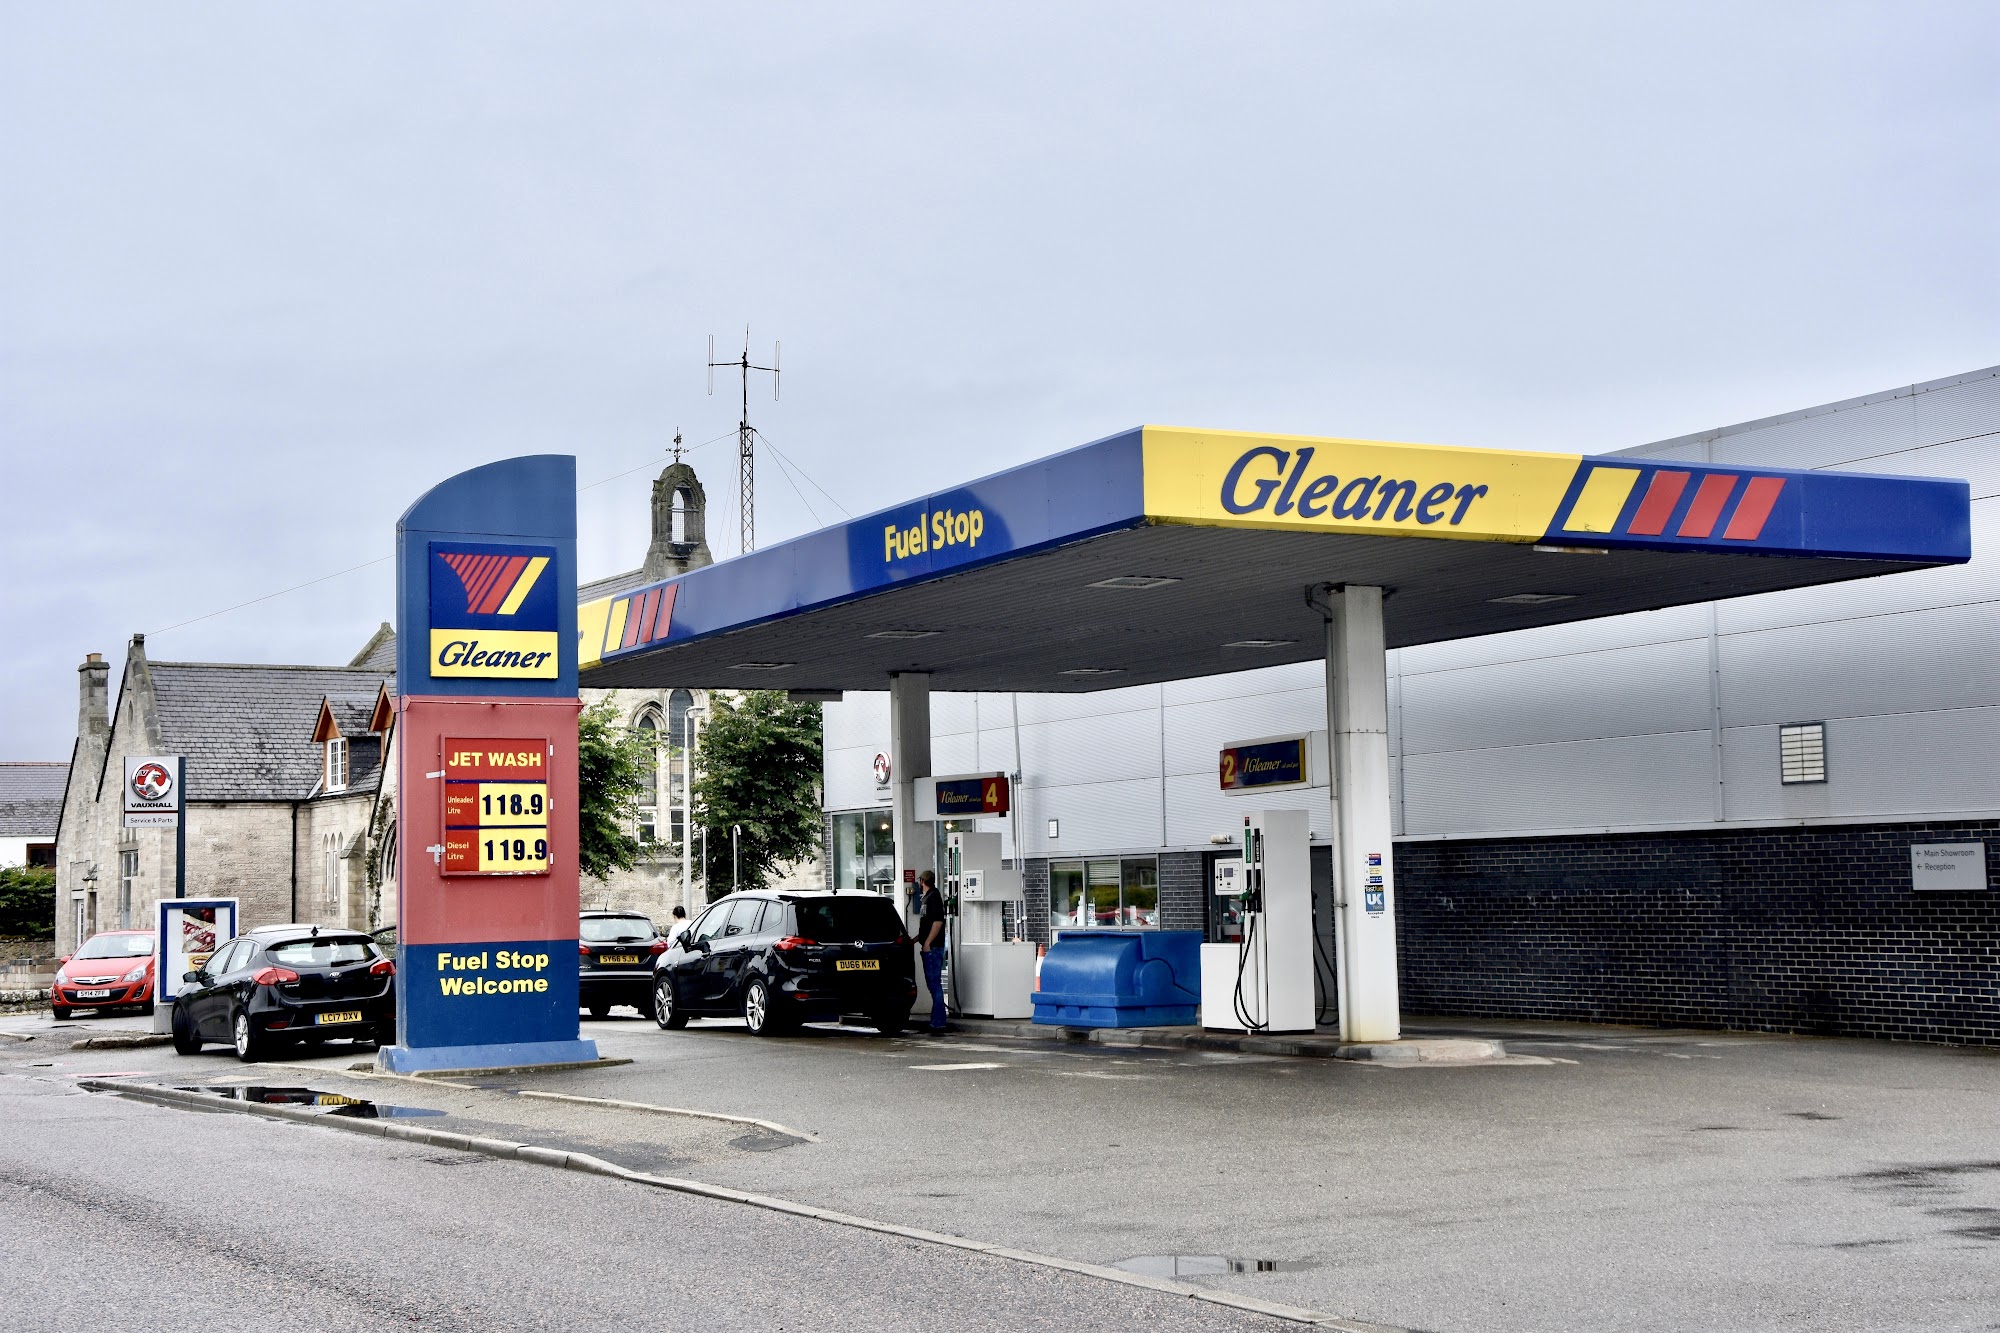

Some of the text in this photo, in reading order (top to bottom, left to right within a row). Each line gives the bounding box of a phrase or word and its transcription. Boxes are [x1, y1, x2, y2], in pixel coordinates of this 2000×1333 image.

[1220, 446, 1489, 525] Gleaner
[884, 508, 984, 562] Fuel Stop
[438, 640, 551, 668] Gleaner
[448, 752, 541, 767] JET WASH
[1248, 757, 1281, 773] Gleaner
[1223, 754, 1235, 784] 2
[945, 791, 969, 804] Gleaner
[985, 782, 998, 807] 4
[447, 793, 543, 815] Unleaded 118.9
[447, 807, 461, 815] Litre
[447, 838, 547, 861] Diesel 119.9
[447, 852, 464, 860] Litre
[1940, 849, 1976, 857] Showroom
[1924, 863, 1956, 872] Reception
[1366, 893, 1383, 905] UK
[437, 950, 549, 972] Fuel Stop
[840, 960, 877, 969] DU66 NXK
[440, 976, 548, 996] Welcome
[322, 1011, 359, 1023] LC17 DXV
